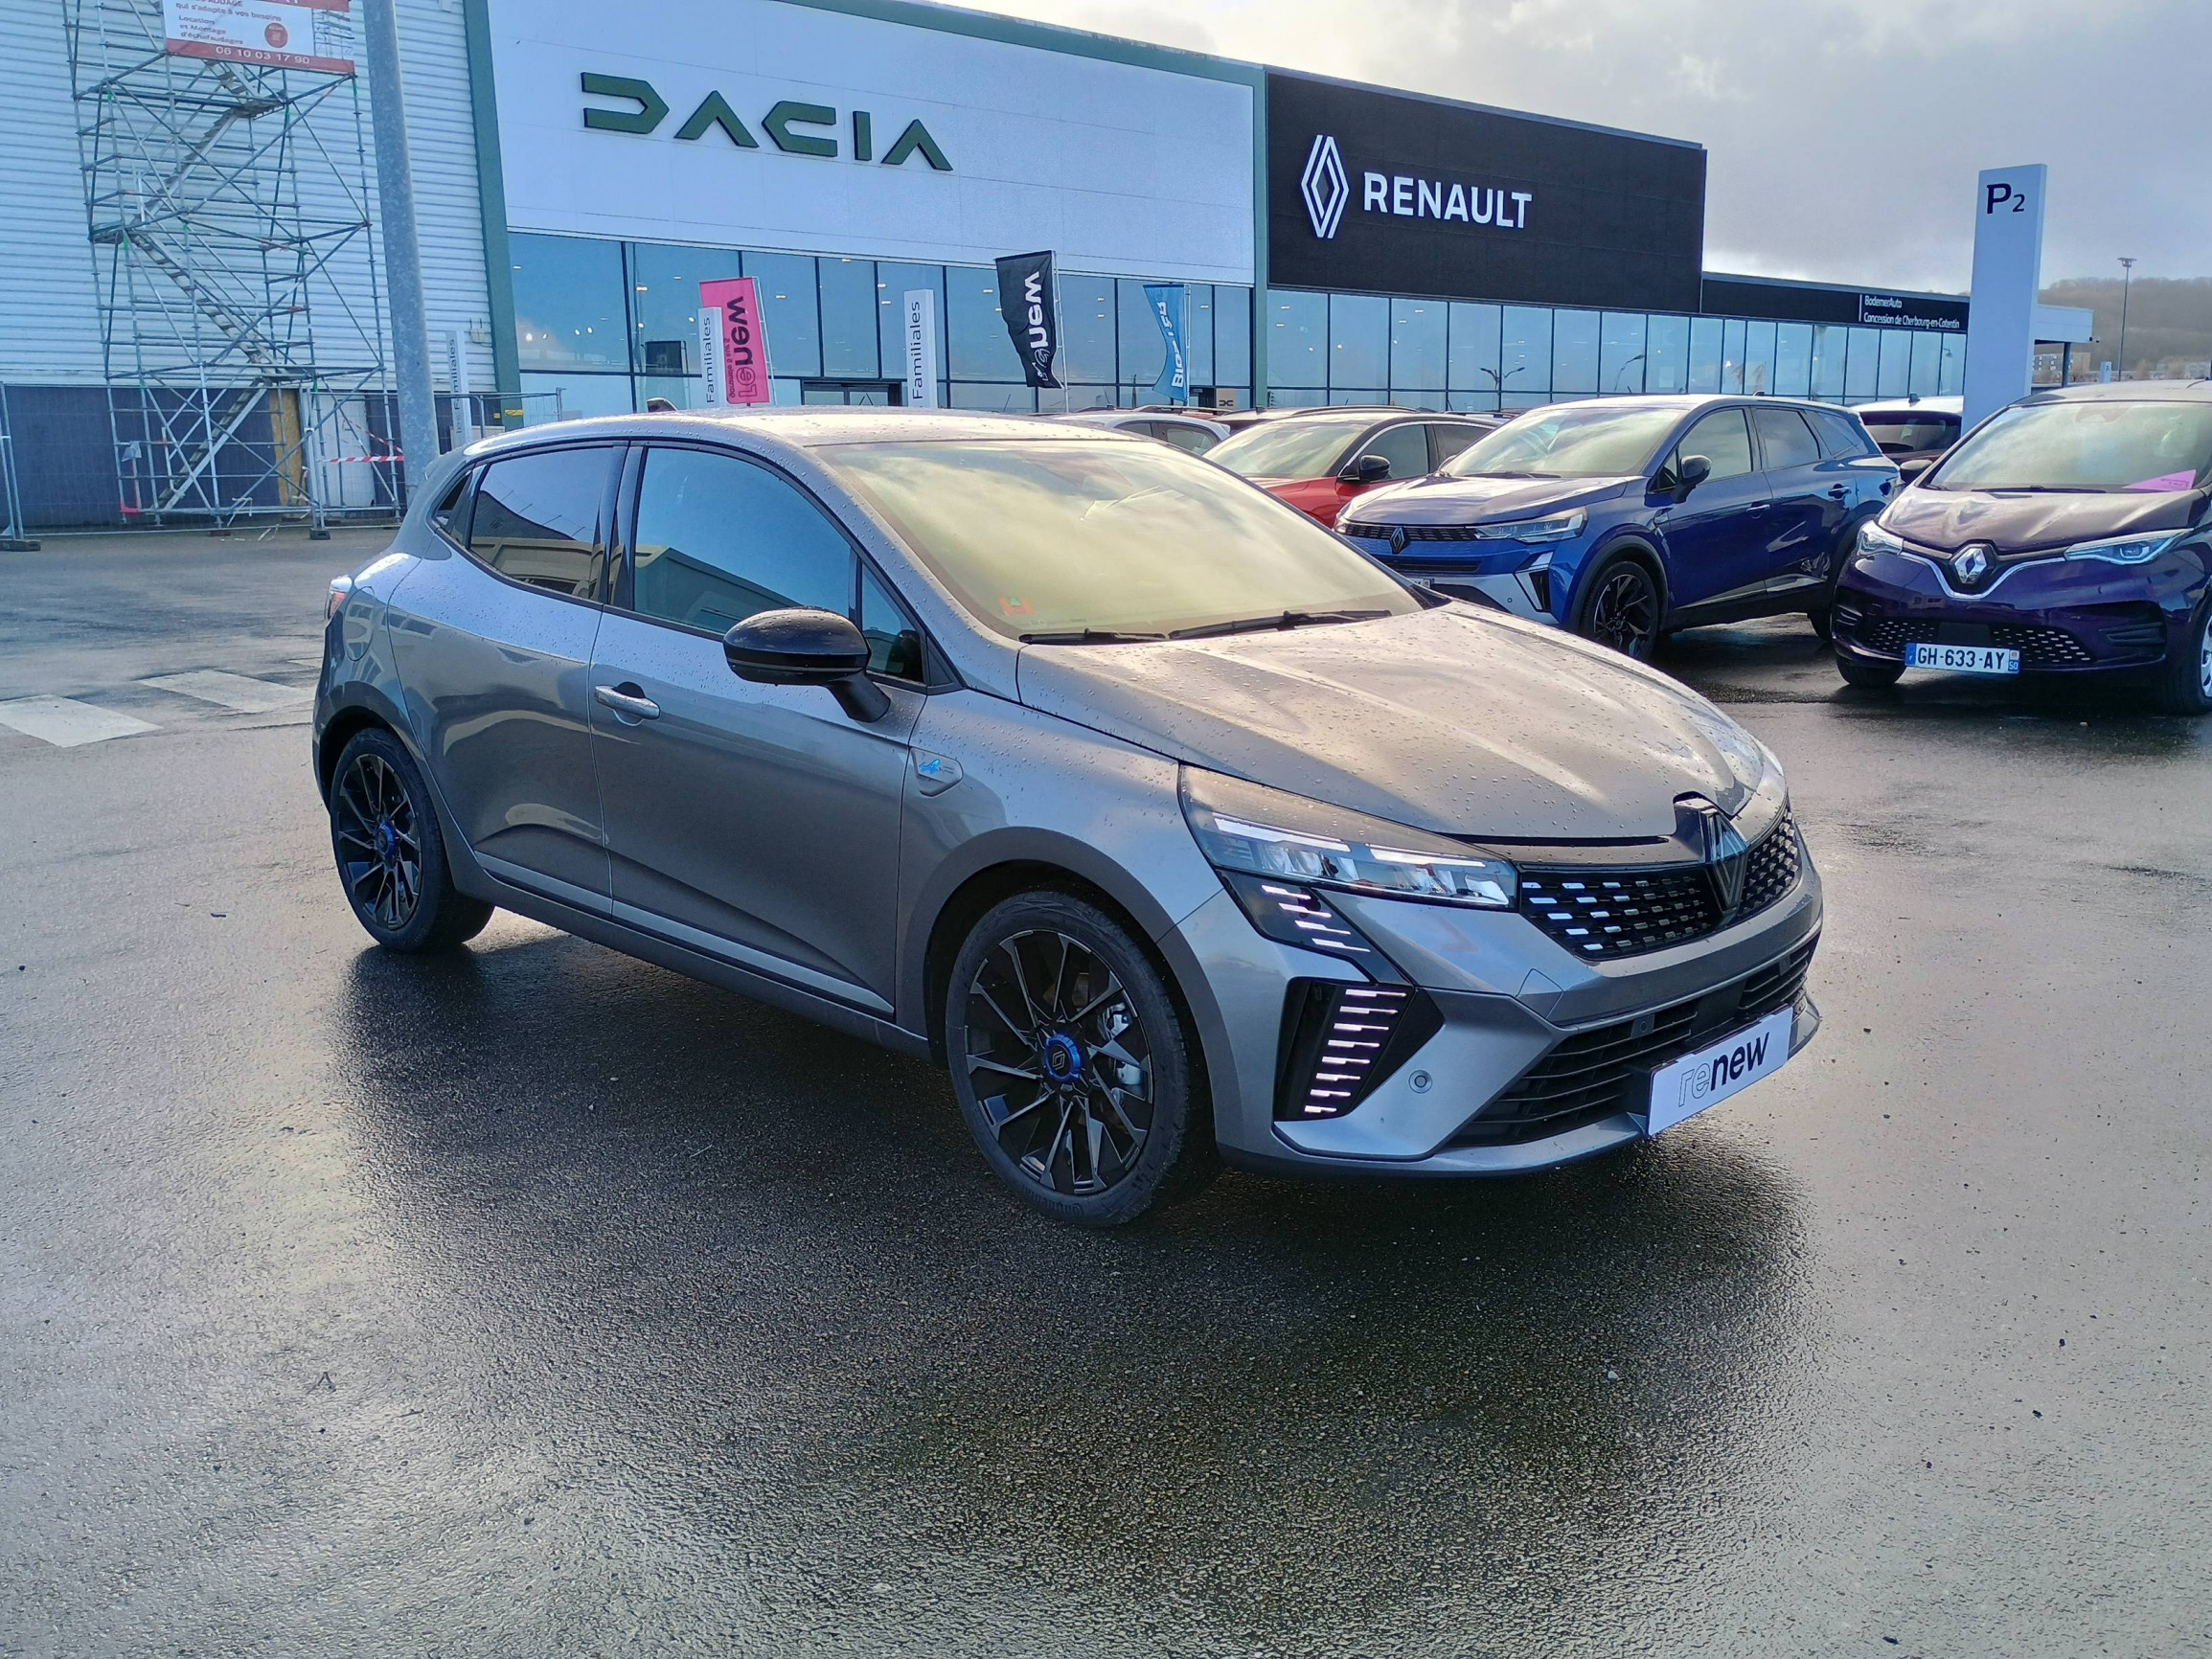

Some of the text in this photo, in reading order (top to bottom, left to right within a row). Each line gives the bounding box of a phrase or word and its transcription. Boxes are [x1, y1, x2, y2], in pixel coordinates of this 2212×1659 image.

[178, 14, 216, 25] Location
[191, 25, 226, 34] Montage
[216, 46, 310, 64] 06 10 03 17 90
[581, 72, 954, 171] DACIA
[1363, 171, 1533, 229] RENAULT
[1864, 295, 1903, 308] BodemerAuto
[1863, 312, 1895, 325] Concession
[1895, 314, 1903, 325] de
[702, 317, 715, 403] Familiales
[910, 301, 924, 399] Familiales
[1917, 647, 2005, 670] GH-633-AY
[2008, 661, 2018, 670] 50
[1678, 1032, 1770, 1108] renew
